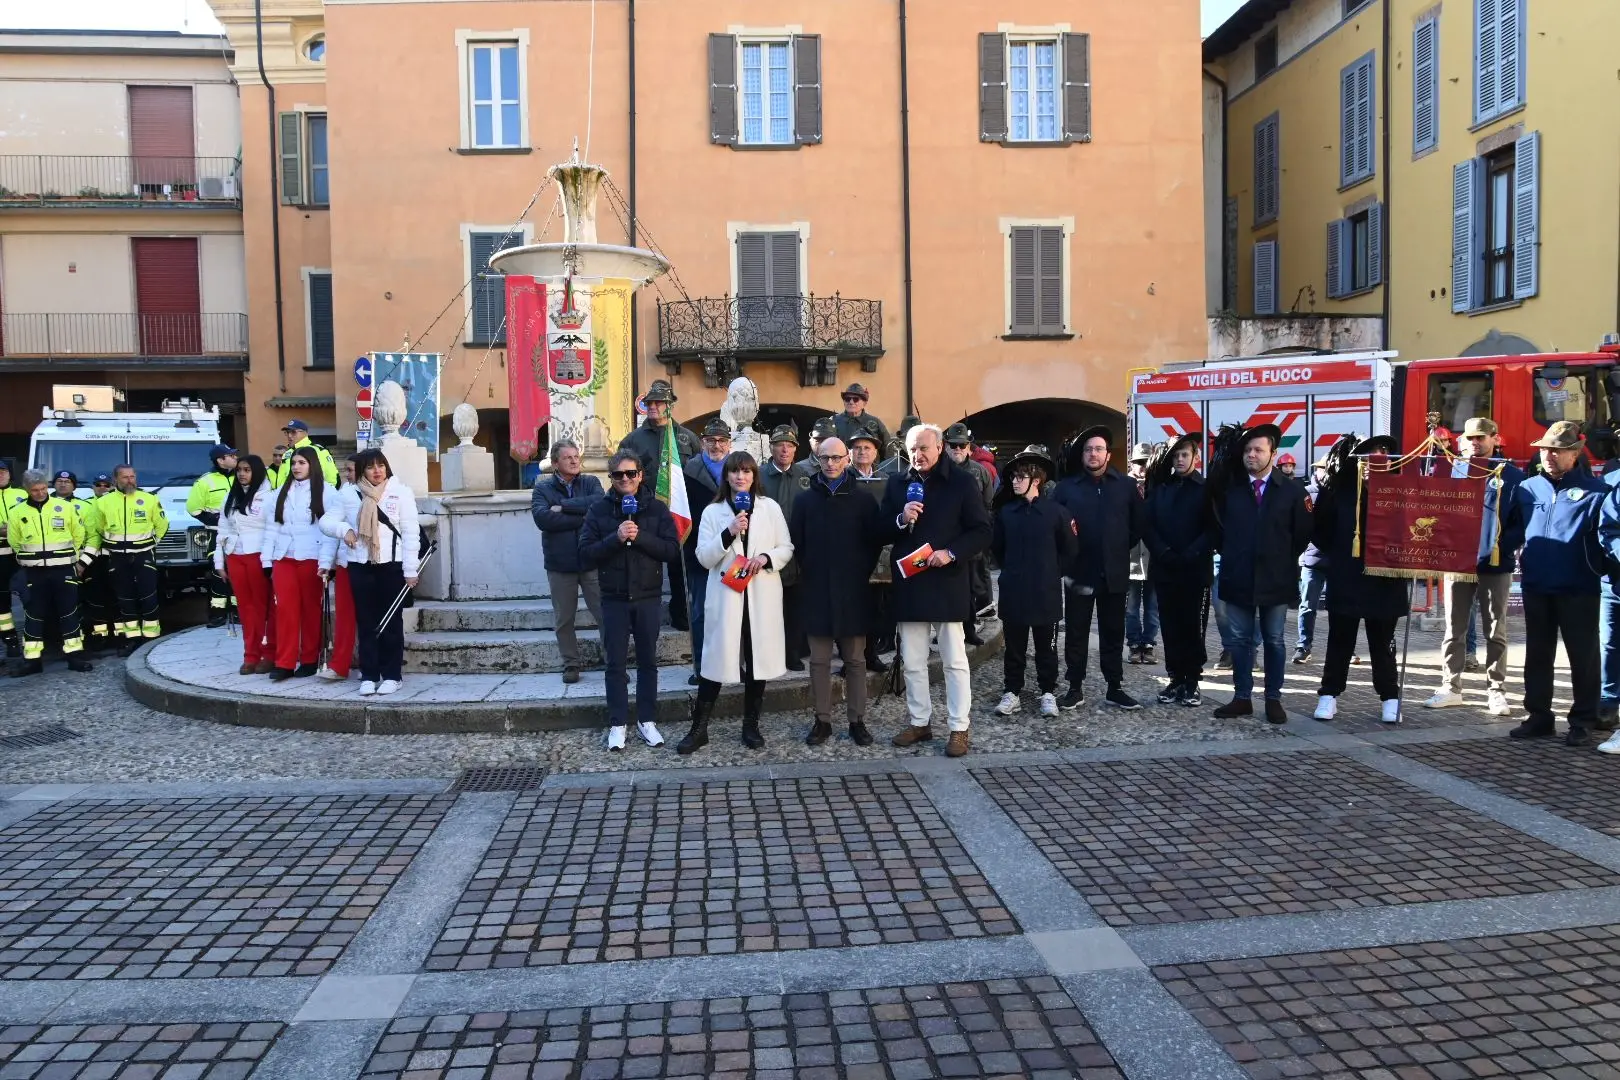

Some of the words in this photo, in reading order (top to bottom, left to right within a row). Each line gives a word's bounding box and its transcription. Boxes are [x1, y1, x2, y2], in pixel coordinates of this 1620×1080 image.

[1188, 374, 1227, 387] VIGILI
[1230, 371, 1258, 385] DEL
[1262, 368, 1312, 383] FUOCO
[1419, 488, 1475, 499] BERSAGLIERI
[1444, 505, 1474, 513] GIUDICI
[1384, 546, 1439, 557] PALAZZOLO
